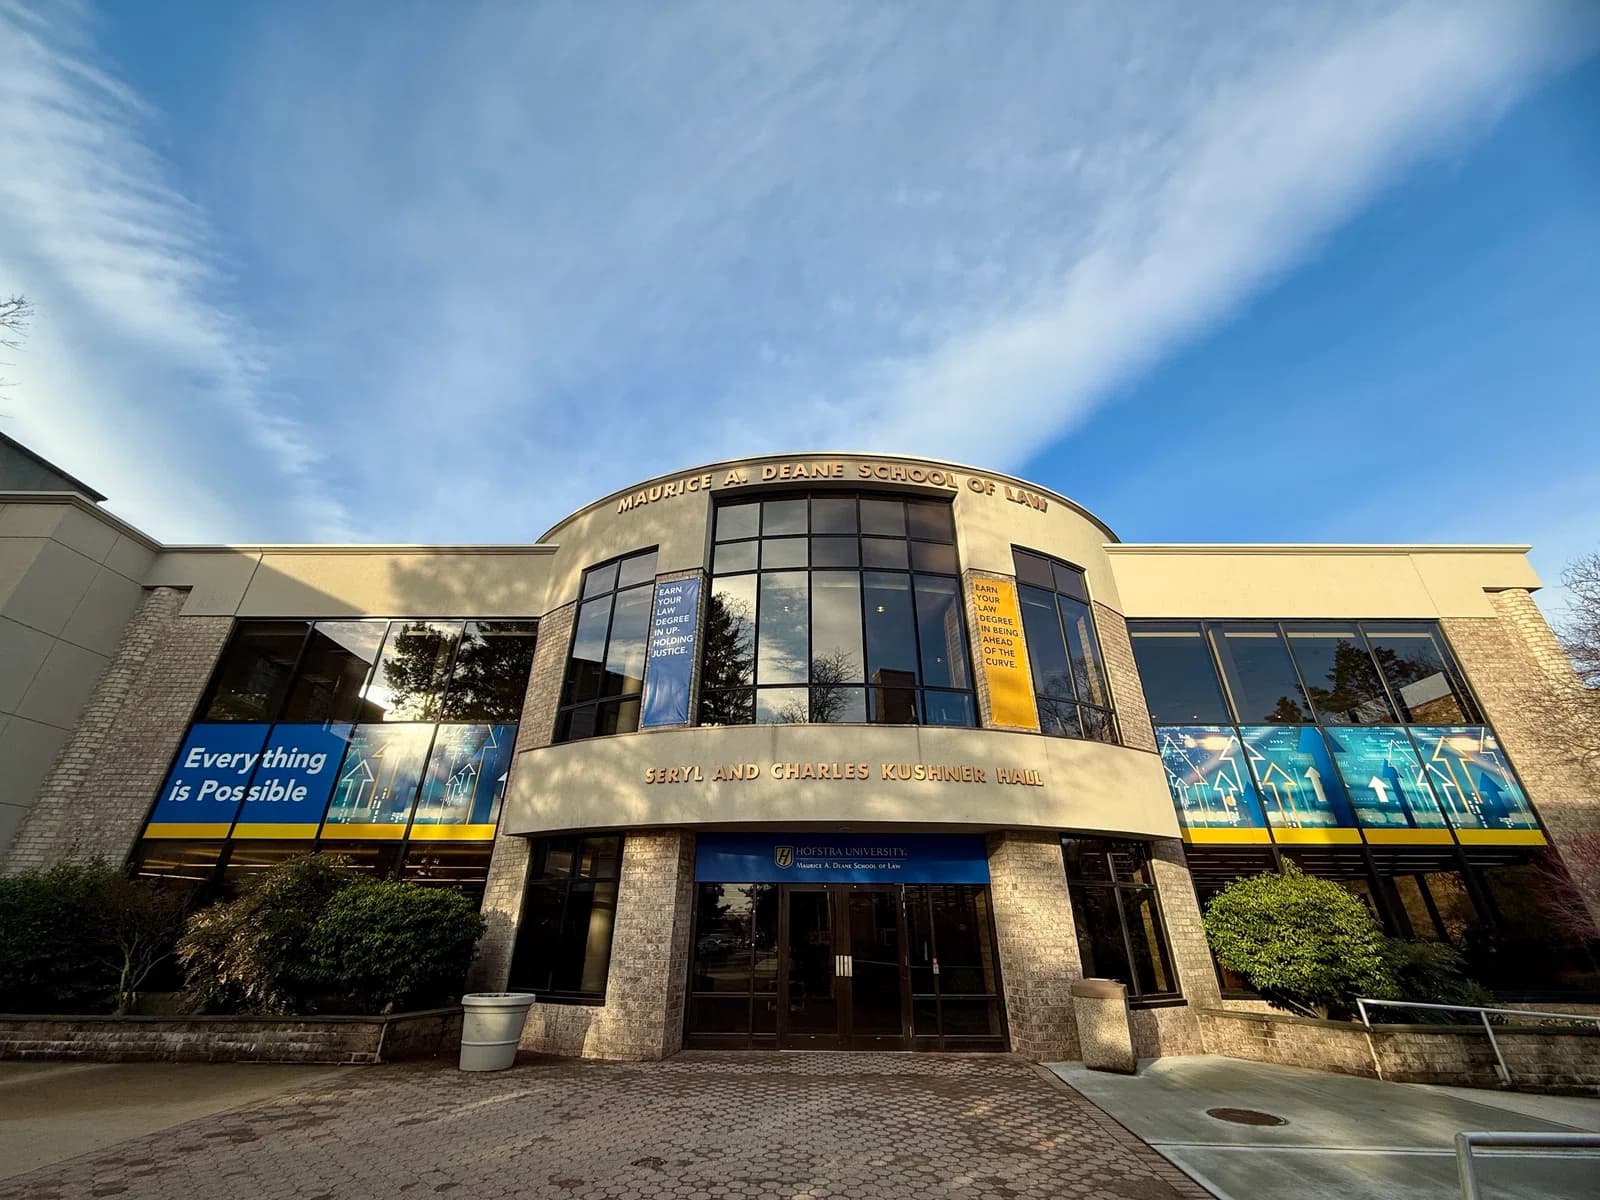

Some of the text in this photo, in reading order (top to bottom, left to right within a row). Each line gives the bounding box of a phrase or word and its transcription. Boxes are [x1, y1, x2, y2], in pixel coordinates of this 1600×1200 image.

[617, 463, 1049, 514] MAURICE A. DEANE SCHOOL OF LAW
[659, 586, 682, 596] EARN
[975, 584, 998, 594] EARN
[658, 596, 682, 606] YOUR
[976, 594, 1000, 604] YOUR
[657, 607, 676, 616] LAW
[978, 605, 997, 613] LAW
[656, 615, 690, 626] DEGREE
[980, 614, 1013, 626] DEGREE
[654, 628, 664, 636] IN
[981, 625, 1019, 637] IN BEING
[653, 635, 693, 647] HOLDING
[983, 636, 1013, 646] AHEAD
[652, 647, 688, 658] JUSTICE.
[984, 647, 1015, 657] OF THE
[985, 658, 1017, 668] CURVE.
[184, 747, 327, 774] Everything
[645, 763, 1044, 787] SERYL AND CHARLES KUSHNER HALL
[168, 780, 309, 802] is Possible
[796, 847, 843, 856] HOFSTRA
